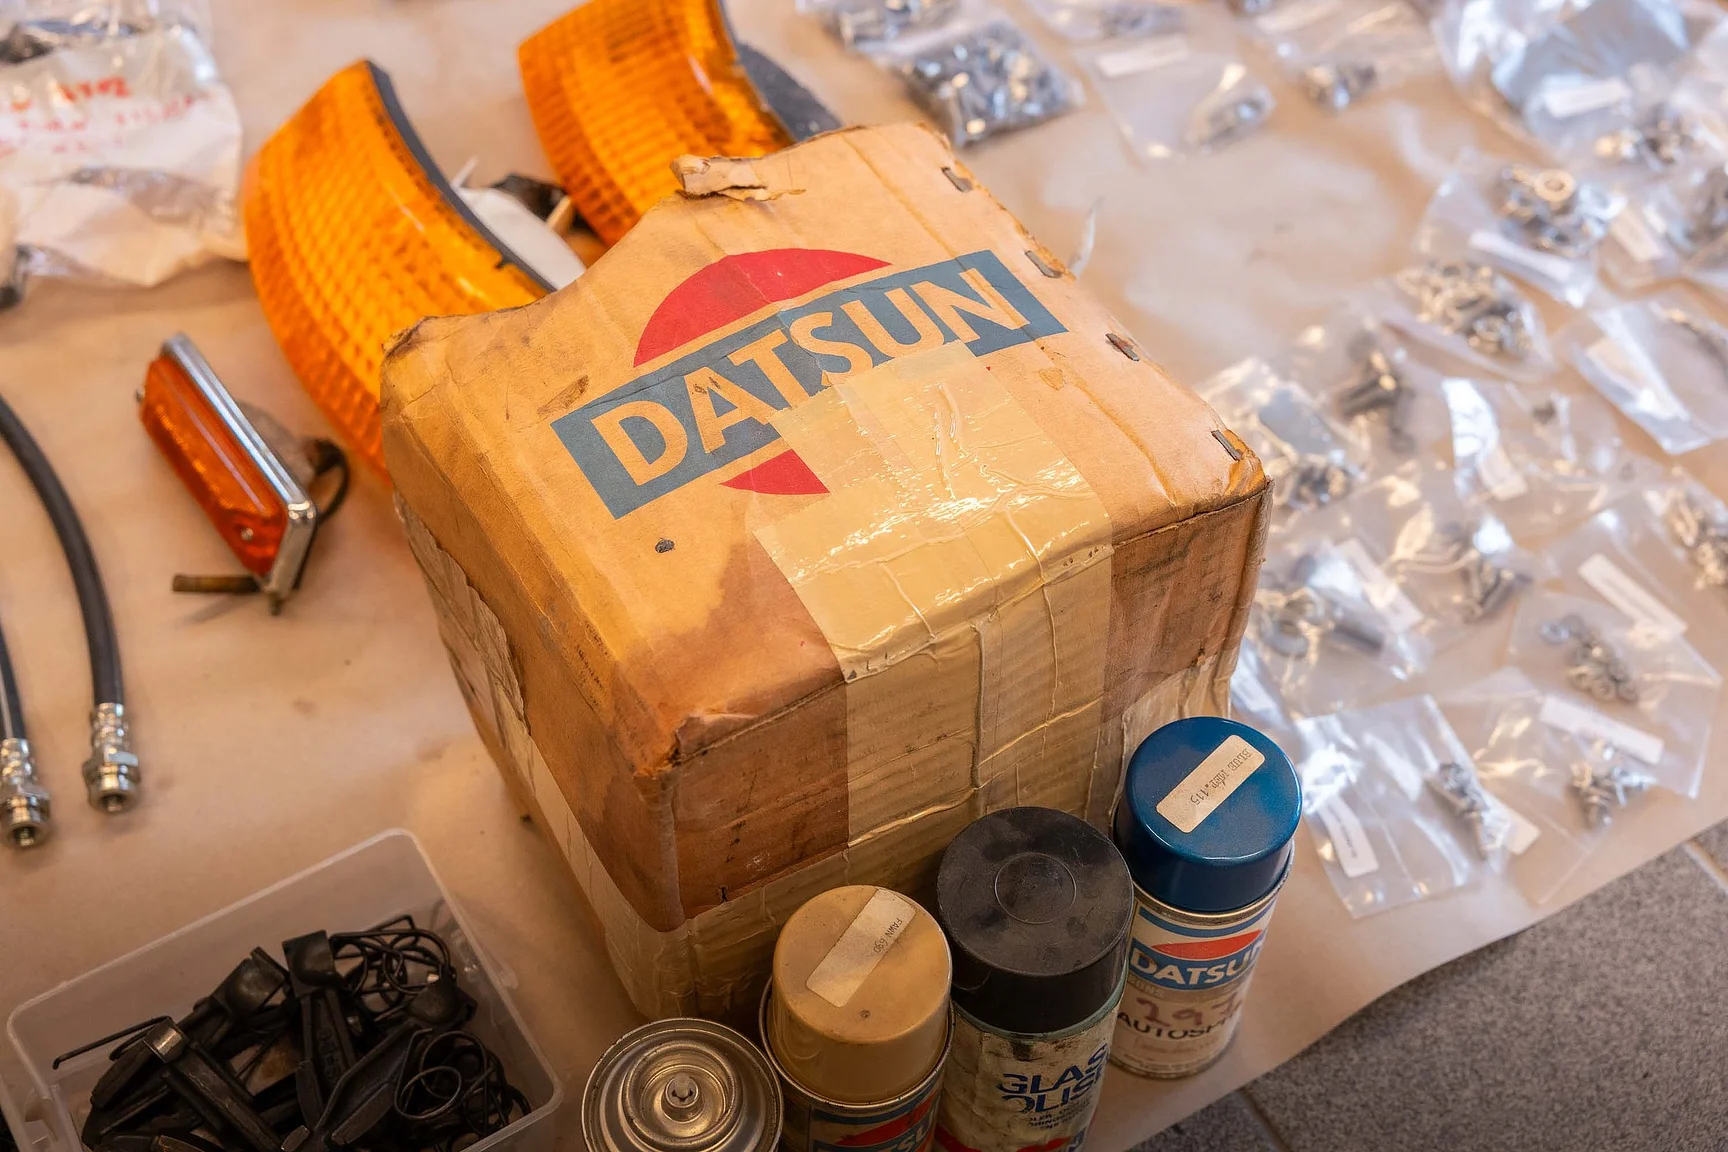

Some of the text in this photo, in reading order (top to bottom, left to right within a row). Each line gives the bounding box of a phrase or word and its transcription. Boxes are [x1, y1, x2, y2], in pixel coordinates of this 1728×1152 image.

[590, 268, 1031, 486] DATSUN
[1227, 748, 1253, 772] BLUE
[884, 917, 903, 938] FAWN
[995, 1042, 1109, 1094] GLAS
